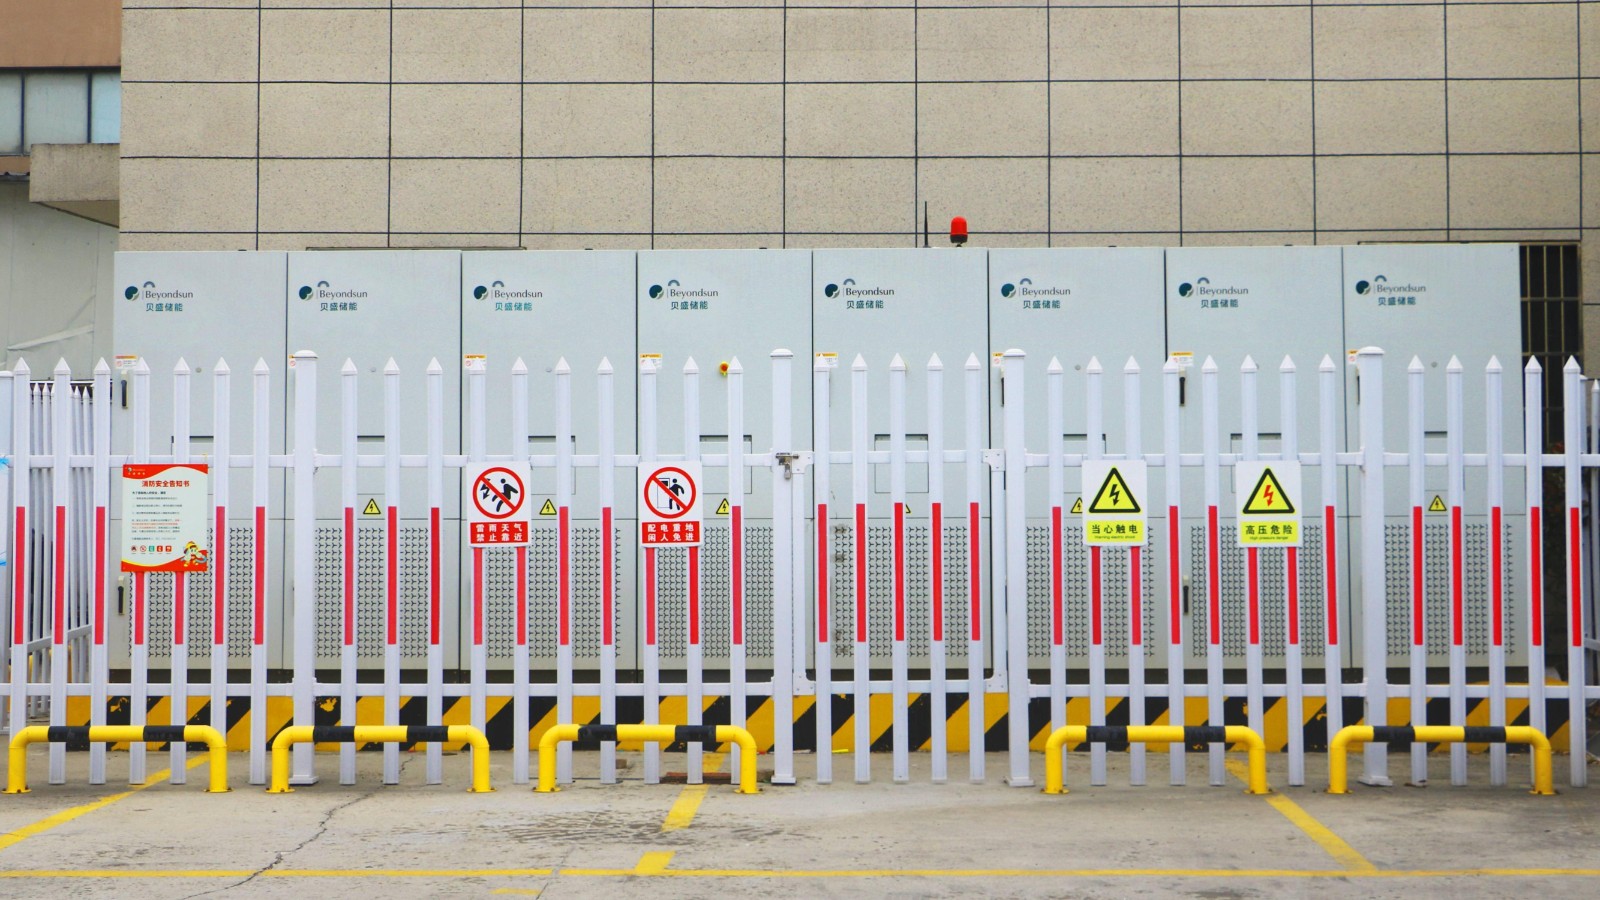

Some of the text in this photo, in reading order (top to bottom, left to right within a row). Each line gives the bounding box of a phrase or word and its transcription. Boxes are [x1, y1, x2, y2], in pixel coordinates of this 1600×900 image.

[670, 288, 719, 299] Beyondsun
[845, 286, 895, 297] Beyondsun
[1022, 286, 1071, 297] Beyondsun
[1200, 286, 1249, 297] Beyondsun
[1376, 283, 1426, 294] Beyondsun
[145, 290, 194, 300] Beyondsun
[319, 290, 368, 300] Beyondsun
[494, 289, 543, 300] Beyondsun
[671, 301, 709, 310] 贝盛储能
[846, 300, 884, 309] 贝盛储能
[1023, 300, 1061, 309] 贝盛储能
[1201, 299, 1239, 308] 贝盛储能
[1378, 296, 1416, 306] 贝盛储能
[145, 302, 183, 312] 贝盛储能
[320, 302, 358, 311] 贝盛储能
[495, 302, 533, 311] 贝盛储能
[142, 480, 190, 488] 消防安全告知书
[476, 524, 523, 533] 雷雨天气
[647, 523, 694, 533] 配电重地
[1092, 524, 1138, 534] 当心触电
[1245, 525, 1293, 535] 高压危险
[476, 533, 523, 542] 禁止靠近
[647, 533, 694, 542] 闲人免进
